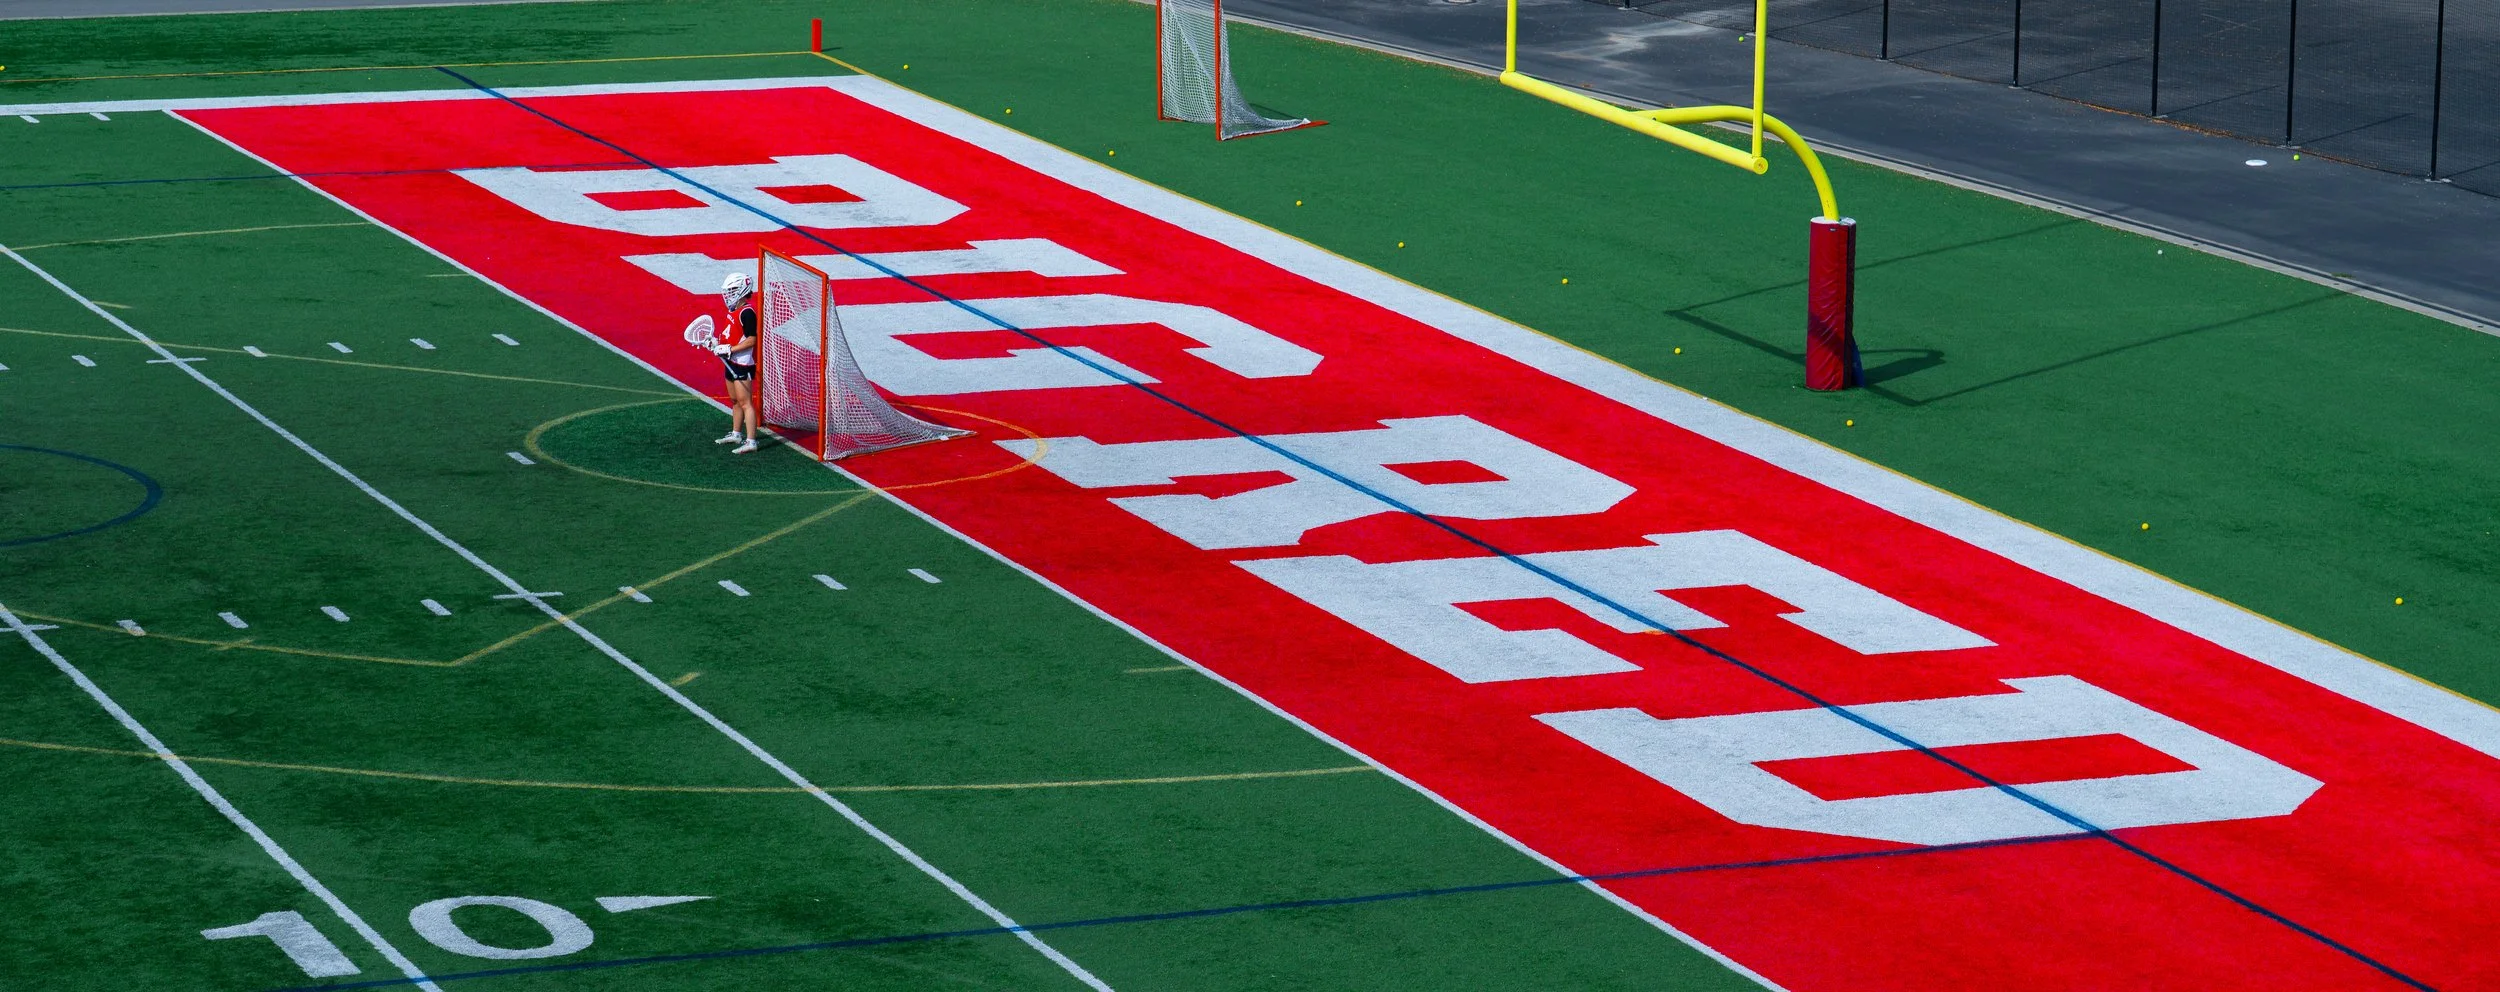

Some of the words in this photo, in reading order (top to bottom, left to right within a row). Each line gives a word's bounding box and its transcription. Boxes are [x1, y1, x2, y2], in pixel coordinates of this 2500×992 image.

[450, 153, 1324, 397] BIG
[992, 415, 2324, 847] RED
[200, 895, 594, 978] 10
